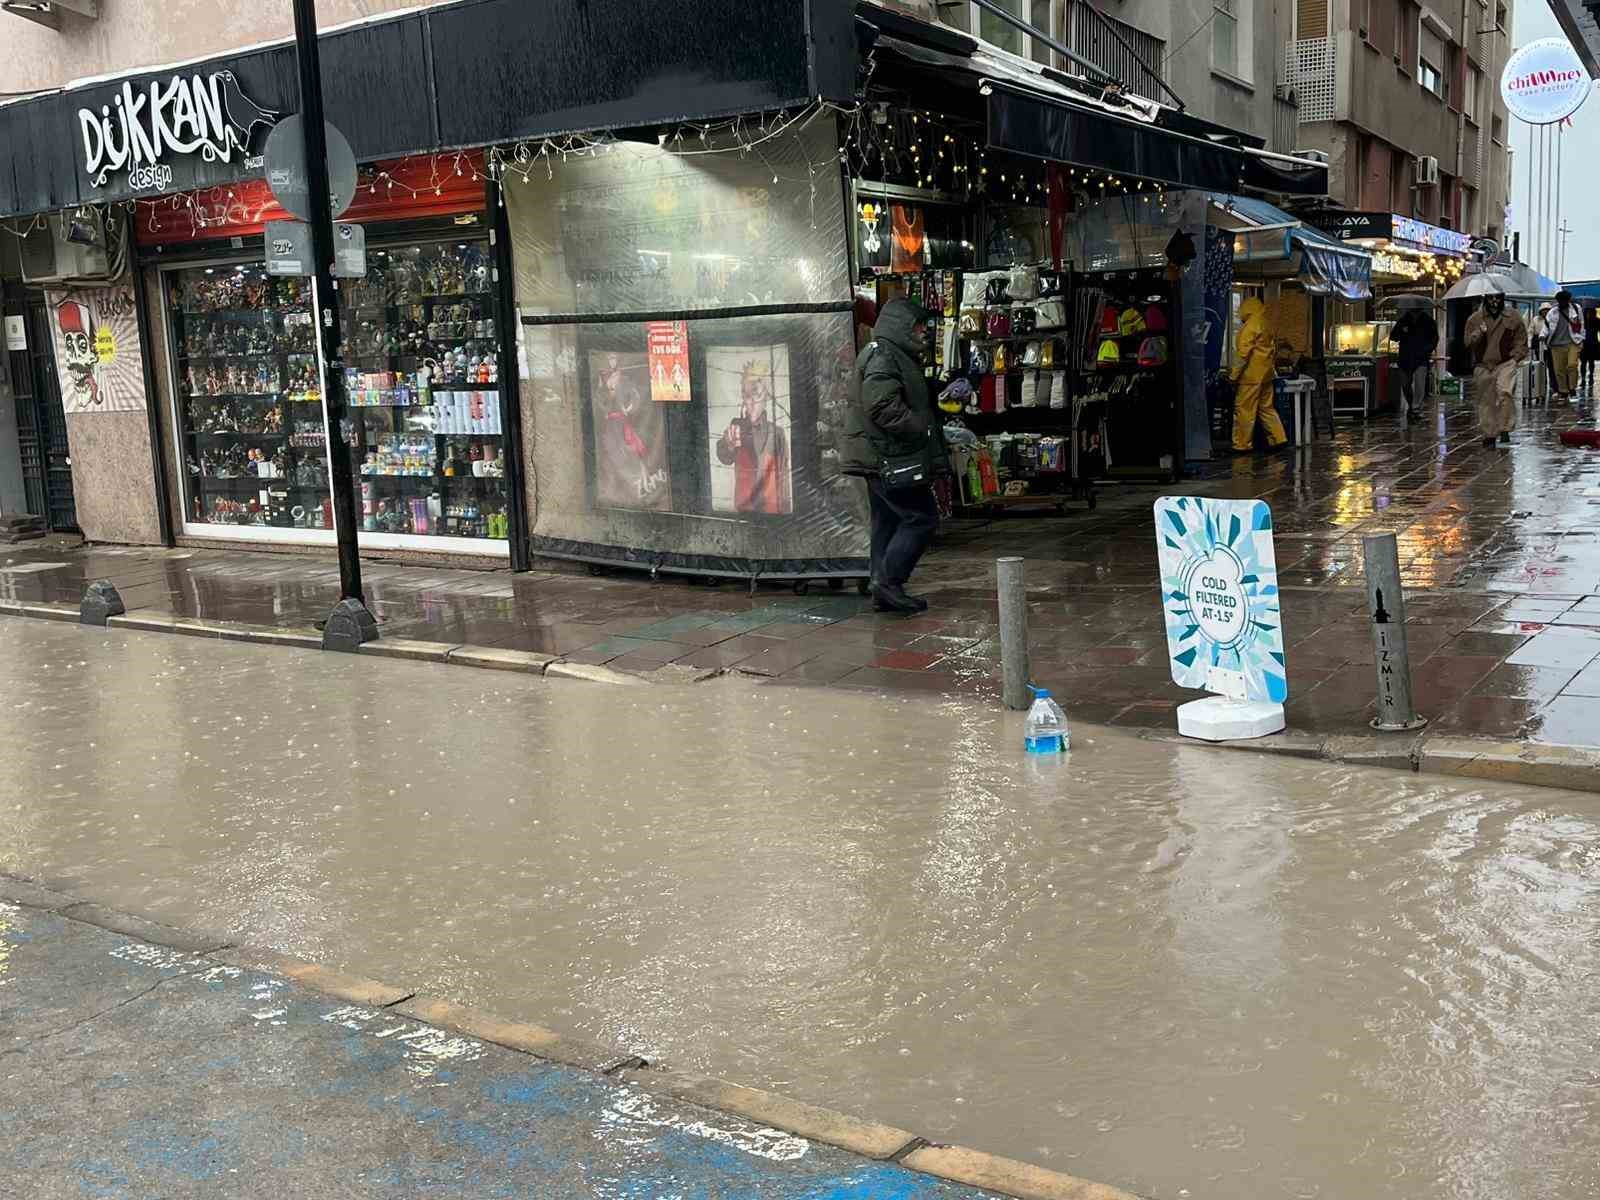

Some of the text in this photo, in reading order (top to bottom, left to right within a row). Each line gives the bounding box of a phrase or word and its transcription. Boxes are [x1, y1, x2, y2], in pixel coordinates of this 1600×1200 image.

[128, 160, 172, 190] design
[1202, 576, 1227, 591] COLD
[1196, 591, 1237, 608] FILTERED
